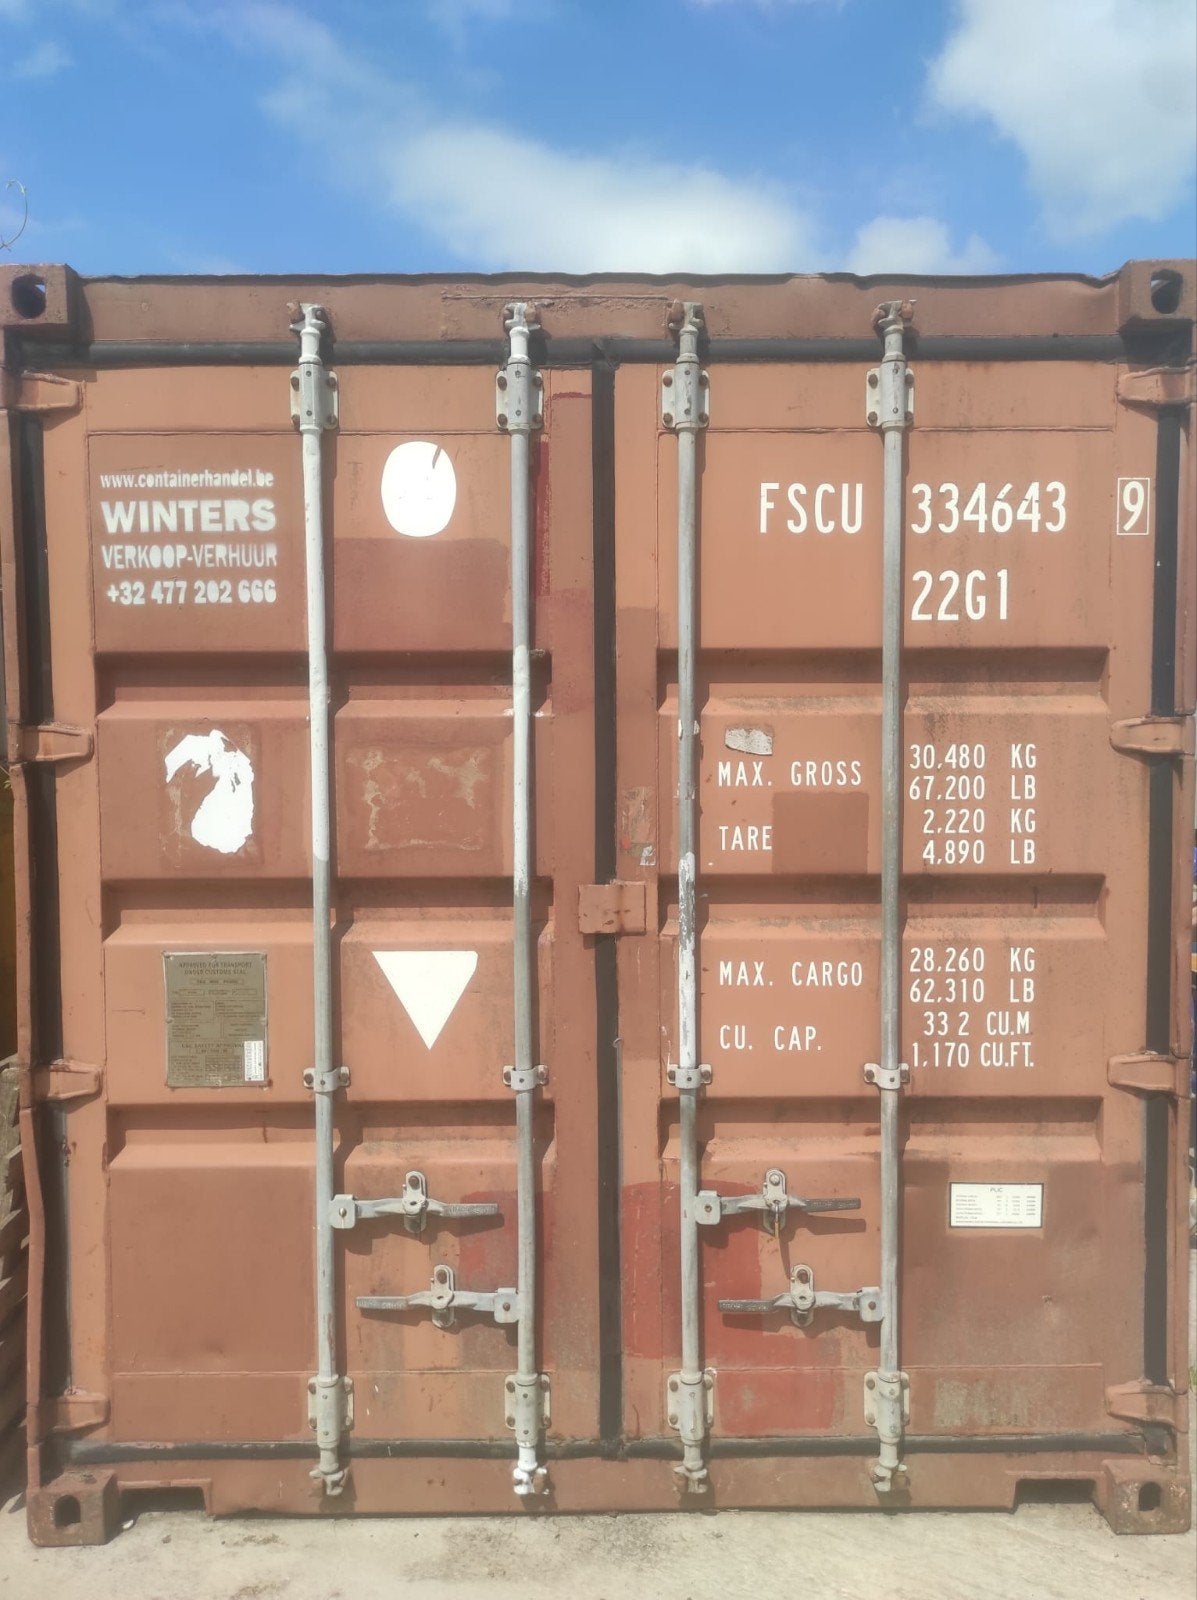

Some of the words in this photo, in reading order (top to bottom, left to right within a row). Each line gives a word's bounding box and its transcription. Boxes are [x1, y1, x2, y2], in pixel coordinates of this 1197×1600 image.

[100, 469, 274, 488] www.containerhandel.be
[100, 499, 276, 533] WINTERS
[759, 483, 863, 534] FSCU
[911, 481, 1067, 534] 334643
[1122, 481, 1145, 532] 9
[101, 544, 277, 569] VERKOOP-VERHUUR
[107, 580, 146, 605] +32
[150, 580, 188, 604] 477
[194, 580, 233, 604] 202
[238, 579, 277, 603] 666
[911, 569, 1008, 621] 22G1
[909, 744, 986, 770] 30,480
[1011, 744, 1037, 769] KG
[718, 761, 772, 787] MAX.
[790, 761, 862, 786] GROSS
[909, 775, 986, 801] 67,200
[1011, 775, 1036, 800] LB
[923, 808, 985, 834] 2,220
[1010, 808, 1036, 833] KG
[718, 825, 773, 851] TARE
[922, 839, 985, 865] 4,890
[1010, 839, 1035, 864] LB
[909, 947, 985, 973] 28,260
[1010, 947, 1035, 972] KG
[719, 961, 774, 986] MAX.
[791, 961, 863, 987] CARGO
[909, 978, 985, 1003] 62,310
[1009, 978, 1035, 1003] LB
[986, 1011, 1030, 1036] CU.M
[719, 1025, 753, 1050] CU.
[774, 1026, 822, 1051] CAP.
[912, 1042, 970, 1068] 1,170
[980, 1042, 1035, 1067] CU.FT.
